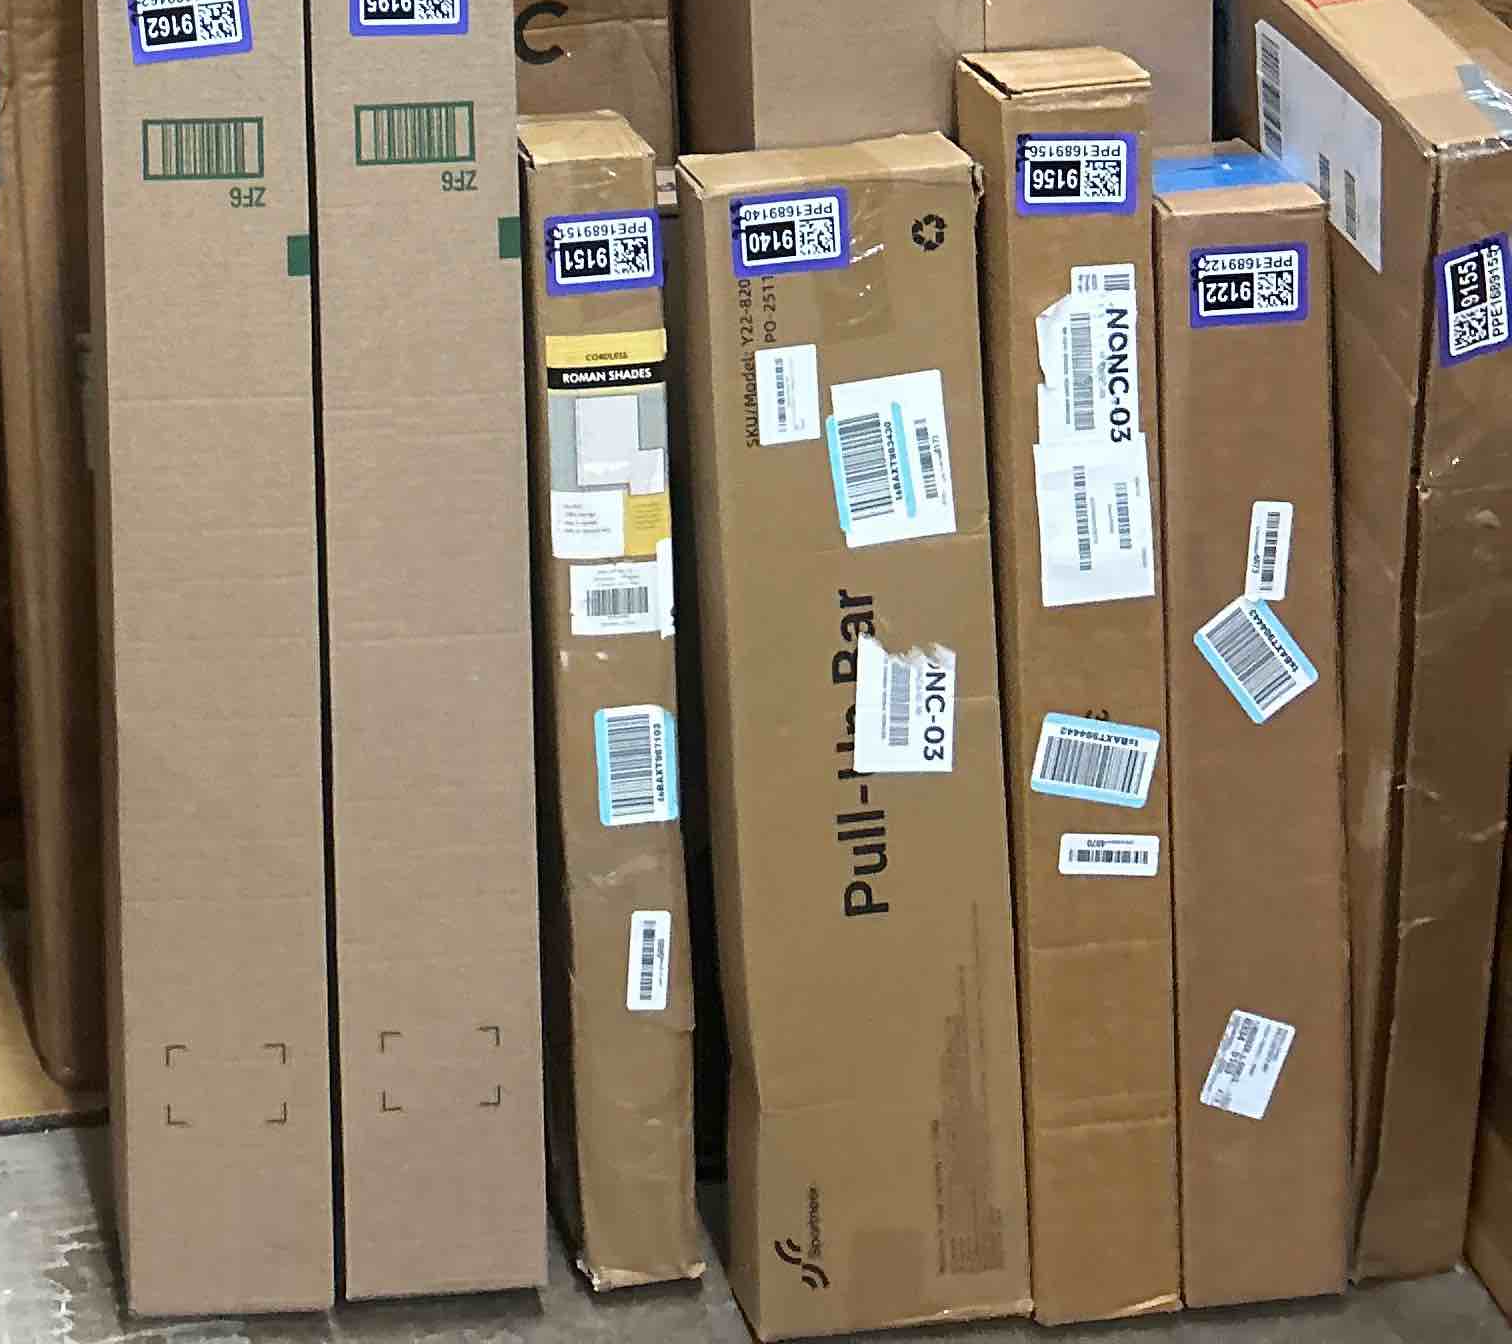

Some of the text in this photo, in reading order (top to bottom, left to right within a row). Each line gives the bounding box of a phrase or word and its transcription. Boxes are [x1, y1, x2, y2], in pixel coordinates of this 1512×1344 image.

[146, 12, 195, 40] 9162
[1028, 144, 1121, 158] PPE1689156
[441, 169, 479, 193] ZF6
[1032, 168, 1079, 190] 9156
[229, 186, 267, 209] ZF6
[744, 202, 833, 221] PPE1689140
[560, 221, 647, 240] PPE1689151
[748, 229, 794, 254] 9140
[564, 246, 609, 272] 9151
[1203, 255, 1293, 272] PPE1689122
[1206, 281, 1252, 304] 9122
[1456, 260, 1481, 308] 9155
[562, 367, 653, 385] ROMAN SHADES
[1105, 308, 1132, 444] NONC-03
[922, 661, 947, 762] NC-03
